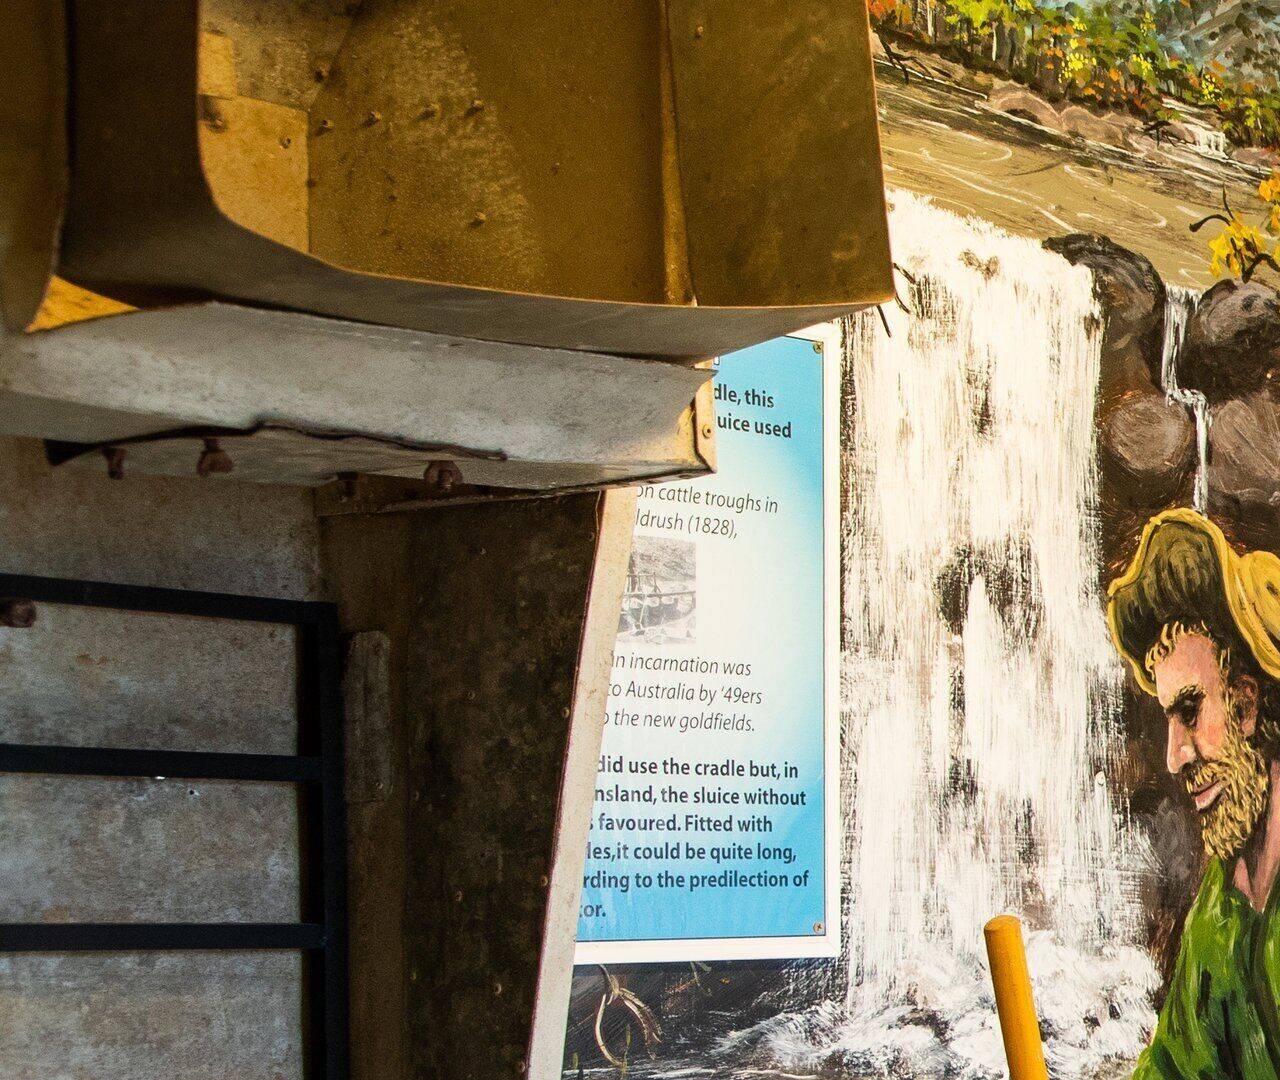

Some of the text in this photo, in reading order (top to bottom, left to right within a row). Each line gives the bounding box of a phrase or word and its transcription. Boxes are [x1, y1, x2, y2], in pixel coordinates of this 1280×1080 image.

[744, 388, 774, 408] this
[754, 421, 791, 438] used
[658, 487, 778, 512] cattle troughs in
[687, 515, 737, 538] (1828),
[629, 653, 751, 676] incarnation was
[625, 681, 762, 704] Australia by '49ers
[614, 709, 754, 731] the new goldfields.
[628, 761, 658, 774] use
[662, 757, 690, 775] the
[694, 759, 745, 776] cradle
[749, 759, 781, 779] but,
[784, 761, 798, 778] in
[660, 786, 688, 803] the
[693, 786, 739, 804] sluice
[743, 787, 806, 805] without
[598, 814, 772, 832] favoured. Fitted with
[633, 842, 680, 859] could
[685, 842, 706, 859] be
[709, 843, 753, 863] quite
[757, 843, 796, 863] long,
[634, 872, 652, 888] to
[656, 870, 685, 888] the
[689, 869, 788, 891] predilection
[792, 869, 809, 887] of
